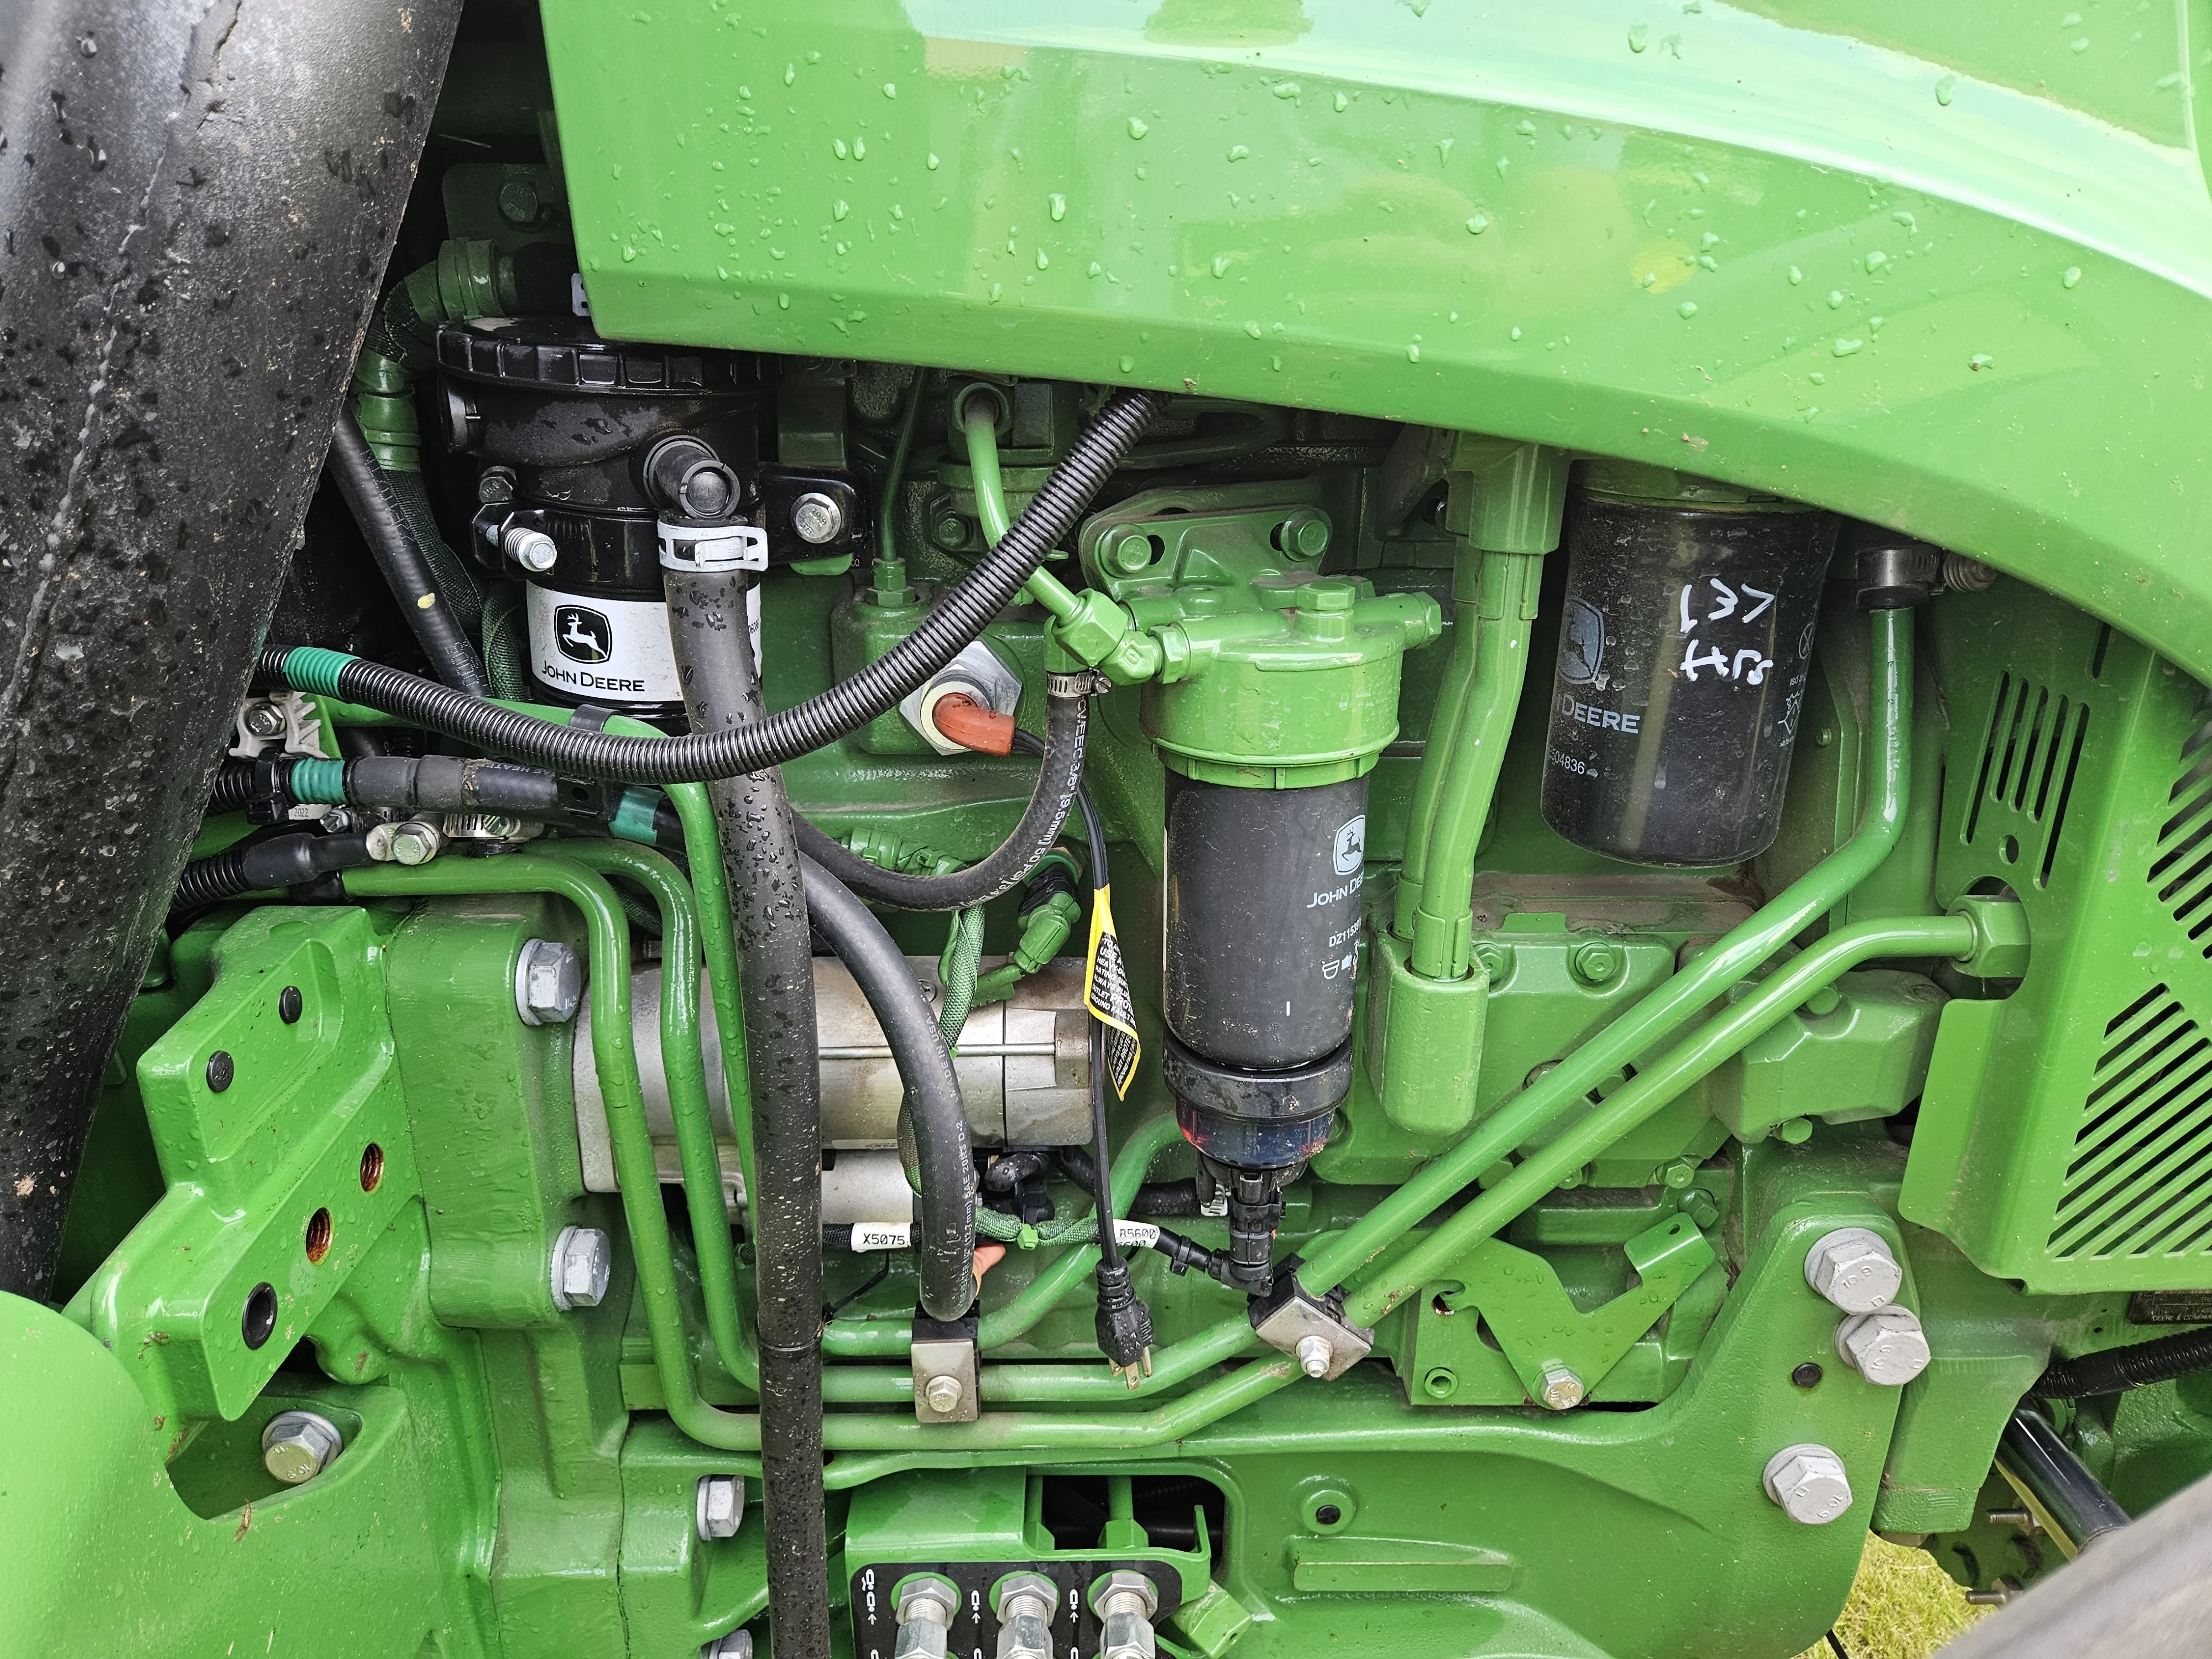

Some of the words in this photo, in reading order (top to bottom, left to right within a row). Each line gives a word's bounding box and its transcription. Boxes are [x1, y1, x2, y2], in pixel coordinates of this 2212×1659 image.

[541, 661, 577, 685] JOHN
[580, 672, 645, 692] DEERE
[1562, 693, 1640, 734] DEERE
[294, 807, 310, 818] 2022
[1307, 885, 1348, 909] JOHN
[1099, 946, 1118, 961] USE
[1095, 965, 1117, 981] RATING
[936, 1045, 946, 1058] IN
[941, 1060, 956, 1098] MADE
[863, 1233, 905, 1245] X5075
